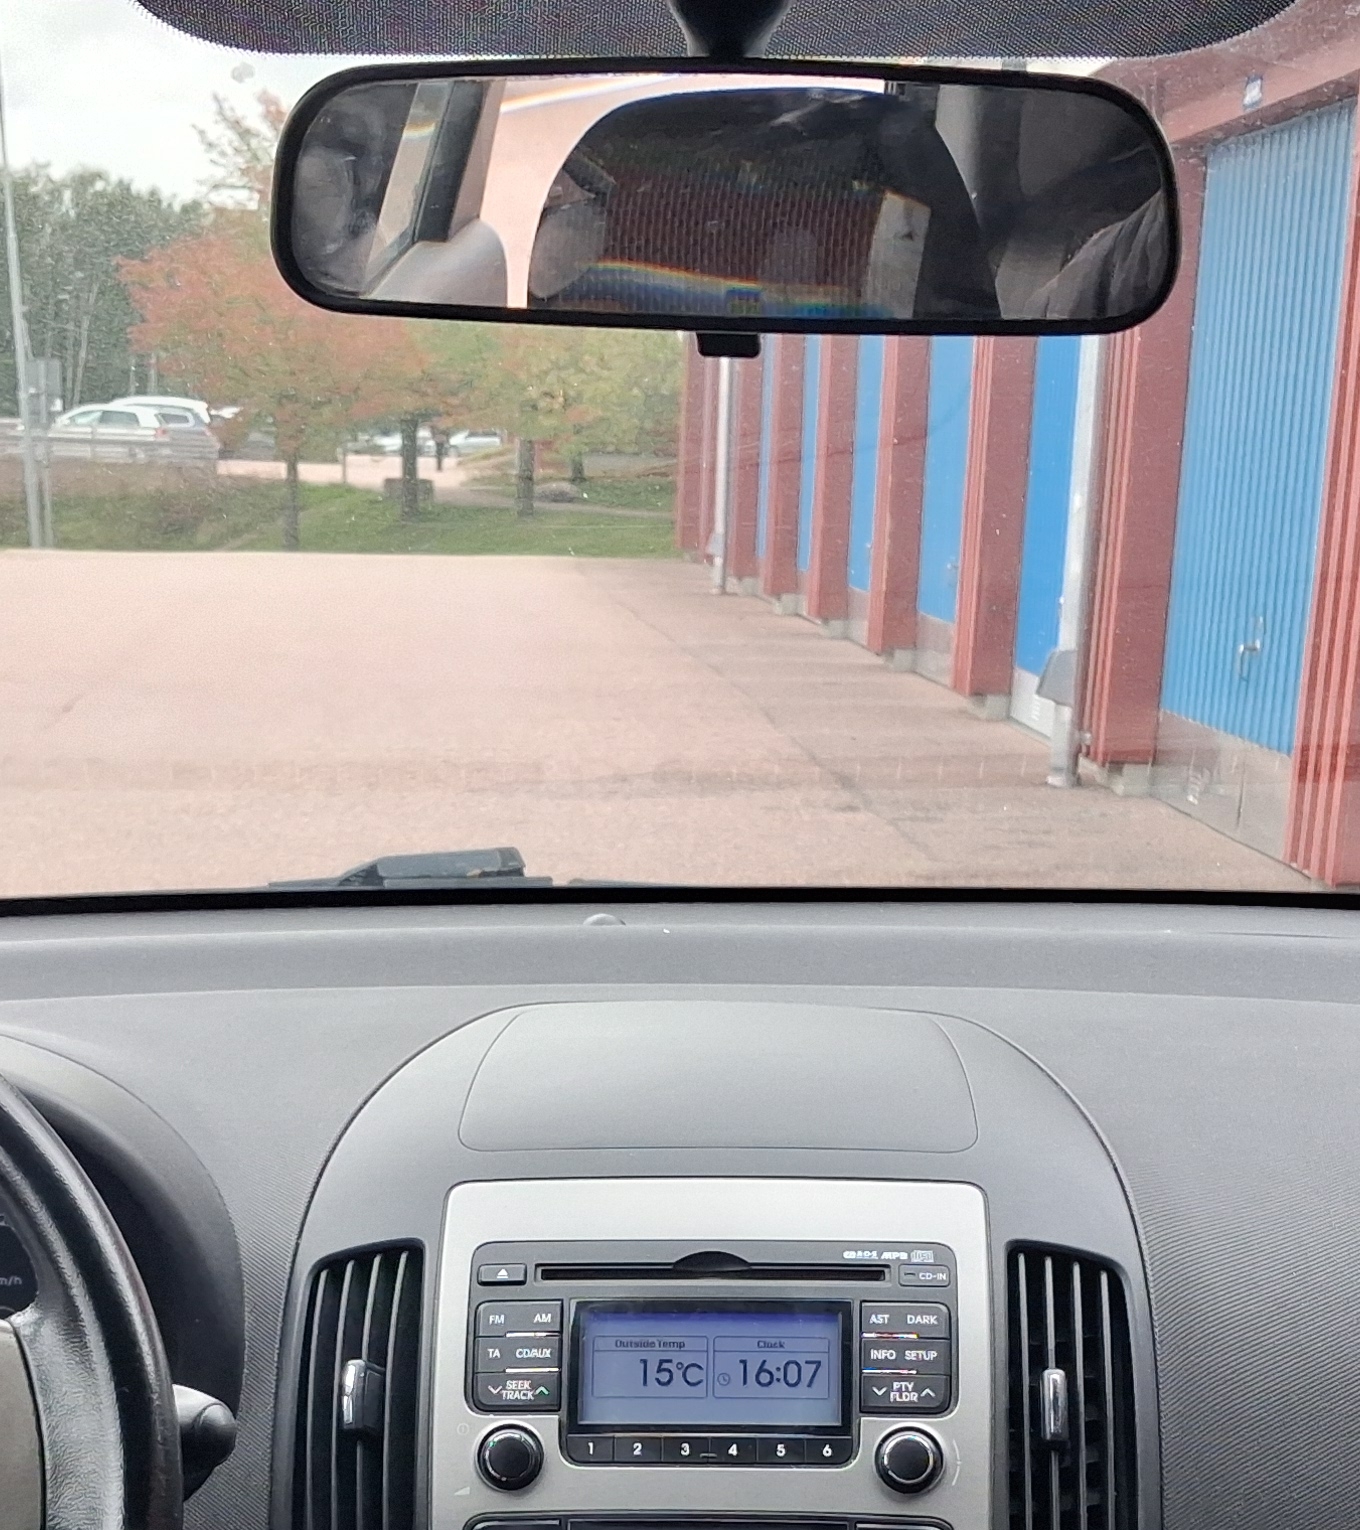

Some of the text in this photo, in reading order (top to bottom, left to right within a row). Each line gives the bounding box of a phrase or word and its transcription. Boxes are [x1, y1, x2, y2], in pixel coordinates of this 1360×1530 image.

[918, 1271, 948, 1281] CD-IN
[488, 1312, 553, 1326] FM AM
[869, 1314, 939, 1325] AST DARK
[614, 1338, 686, 1350] Outside Temp
[756, 1339, 786, 1350] Clock
[487, 1348, 501, 1359] TA
[870, 1348, 938, 1361] INFO SETUP
[738, 1359, 823, 1388] 16:07
[505, 1379, 532, 1391] SEEK
[892, 1381, 915, 1392] PTY
[500, 1389, 536, 1400] TRACK
[889, 1391, 919, 1403] FLDR
[587, 1442, 595, 1456] 1
[632, 1442, 643, 1456] 2
[680, 1442, 690, 1456] 3
[727, 1442, 739, 1456] 4
[776, 1443, 786, 1457] 5
[822, 1443, 833, 1457] 6
